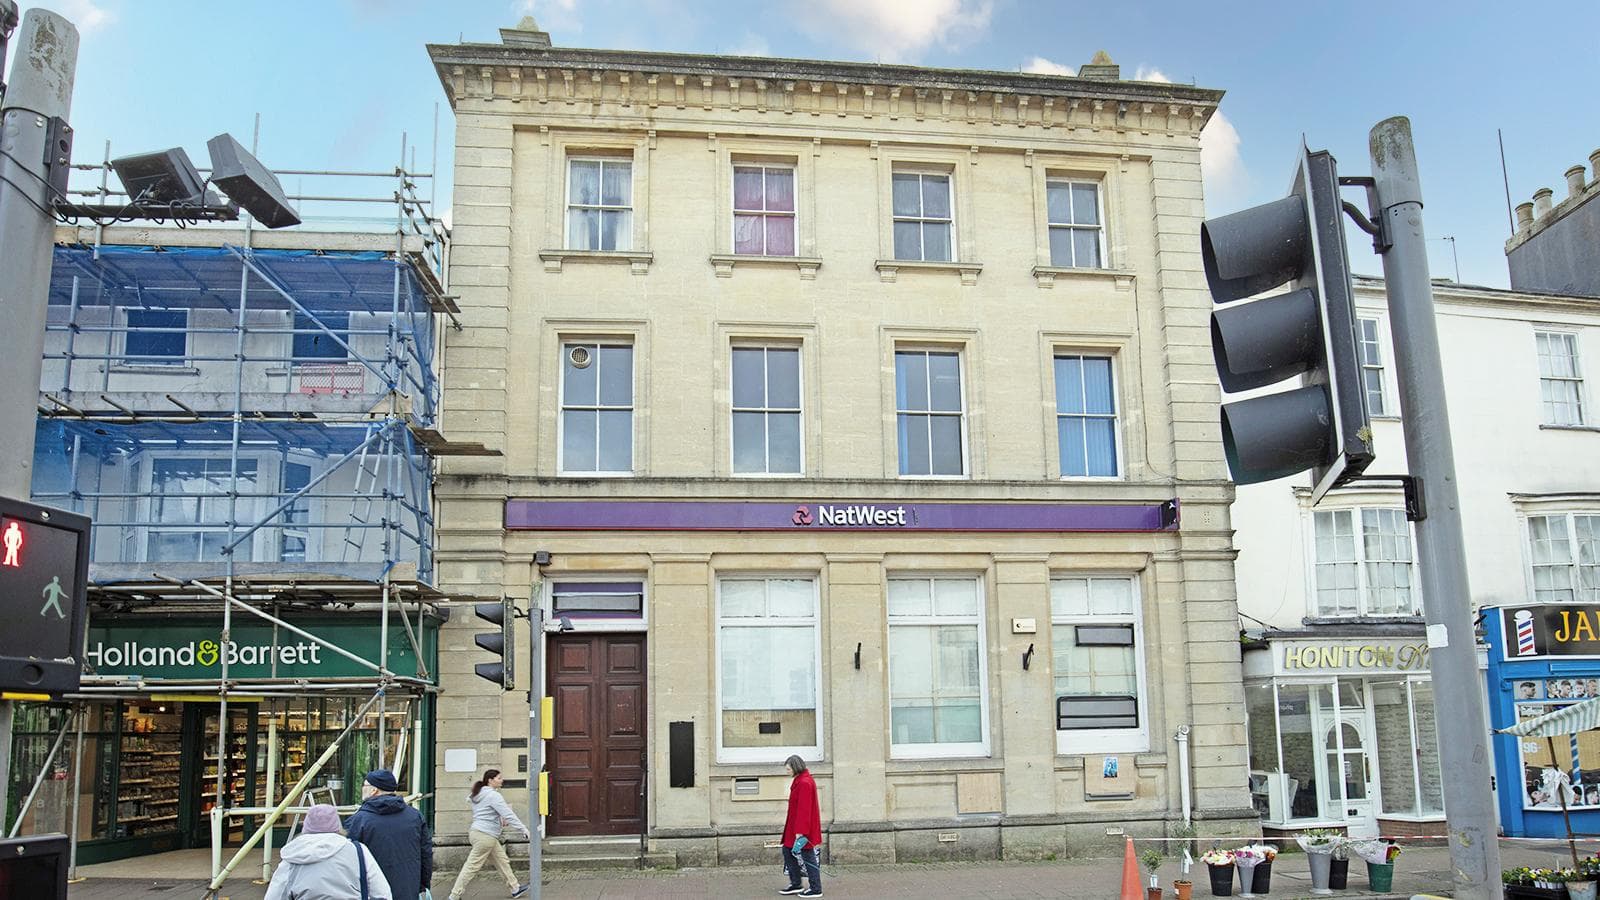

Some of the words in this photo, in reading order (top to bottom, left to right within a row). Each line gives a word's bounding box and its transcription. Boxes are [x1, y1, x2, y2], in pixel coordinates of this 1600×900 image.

[818, 505, 907, 526] NatWest
[1554, 610, 1600, 642] JA
[1283, 644, 1395, 669] HONITON
